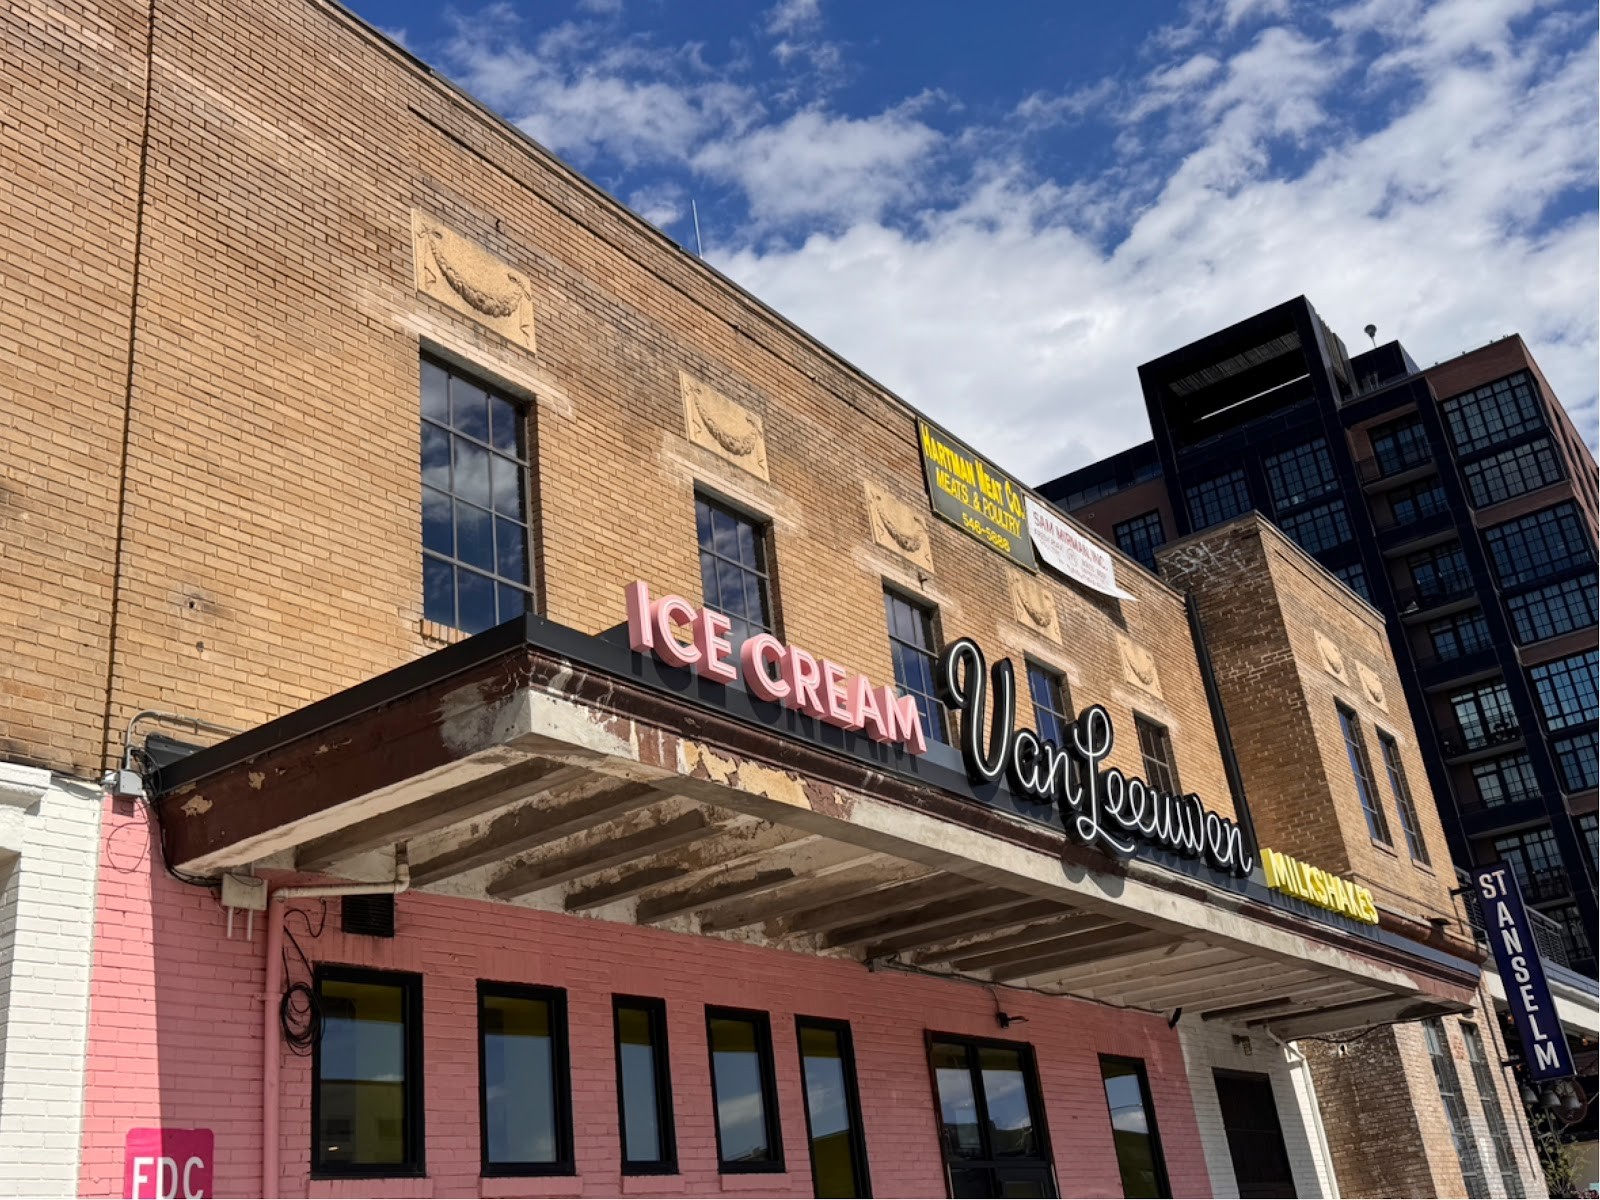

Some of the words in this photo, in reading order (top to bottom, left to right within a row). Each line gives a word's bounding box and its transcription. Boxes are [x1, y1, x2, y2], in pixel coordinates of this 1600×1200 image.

[920, 422, 976, 487] HARTMAN
[975, 459, 1004, 506] MEAT
[936, 467, 969, 504] MEATS
[973, 491, 983, 512] &
[983, 497, 1022, 539] POULTRY
[1033, 511, 1054, 535] SAM
[625, 579, 737, 685] ICE
[741, 633, 927, 754] CREAM
[946, 639, 1083, 805] Van
[1074, 706, 1253, 874] Leeuwen
[1260, 847, 1379, 925] MILKSHAKES
[1479, 869, 1508, 899] ST
[1497, 901, 1560, 1071] ANSELM
[132, 1156, 205, 1199] FDC
